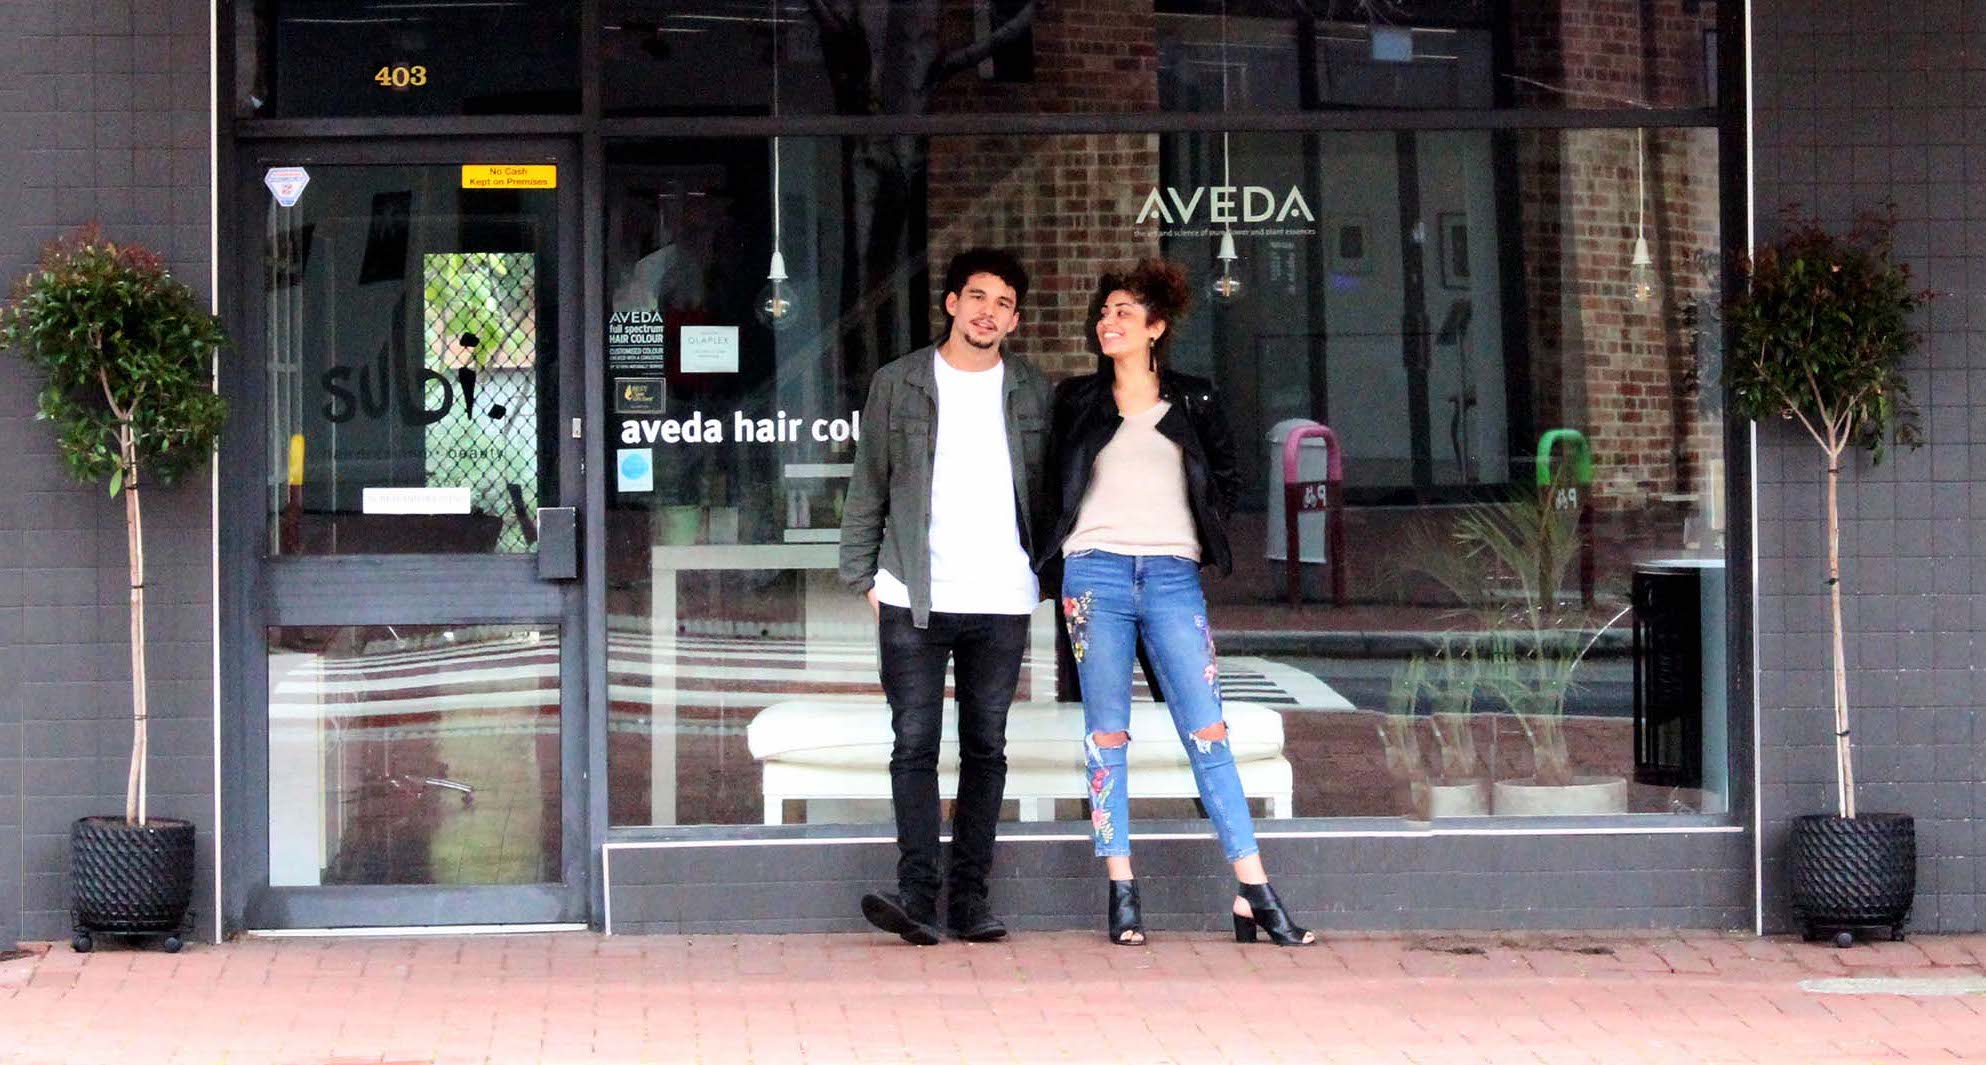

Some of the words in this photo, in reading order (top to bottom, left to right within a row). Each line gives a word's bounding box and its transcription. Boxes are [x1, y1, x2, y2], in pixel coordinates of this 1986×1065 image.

[374, 65, 427, 87] 403
[490, 167, 502, 175] No
[505, 167, 528, 176] Cash
[469, 177, 490, 187] Kept
[507, 177, 548, 186] Premises
[1135, 184, 1315, 224] AVEDA
[1158, 229, 1172, 237] and
[1174, 229, 1200, 237] science
[1200, 229, 1208, 237] of
[1250, 228, 1264, 236] and
[1266, 228, 1284, 237] plant
[609, 311, 663, 323] AVEDA
[610, 324, 622, 333] full
[624, 325, 664, 335] spectrum
[609, 334, 629, 344] HAIR
[630, 334, 664, 344] COLOUR
[621, 411, 723, 444] aveda
[734, 410, 803, 443] hair
